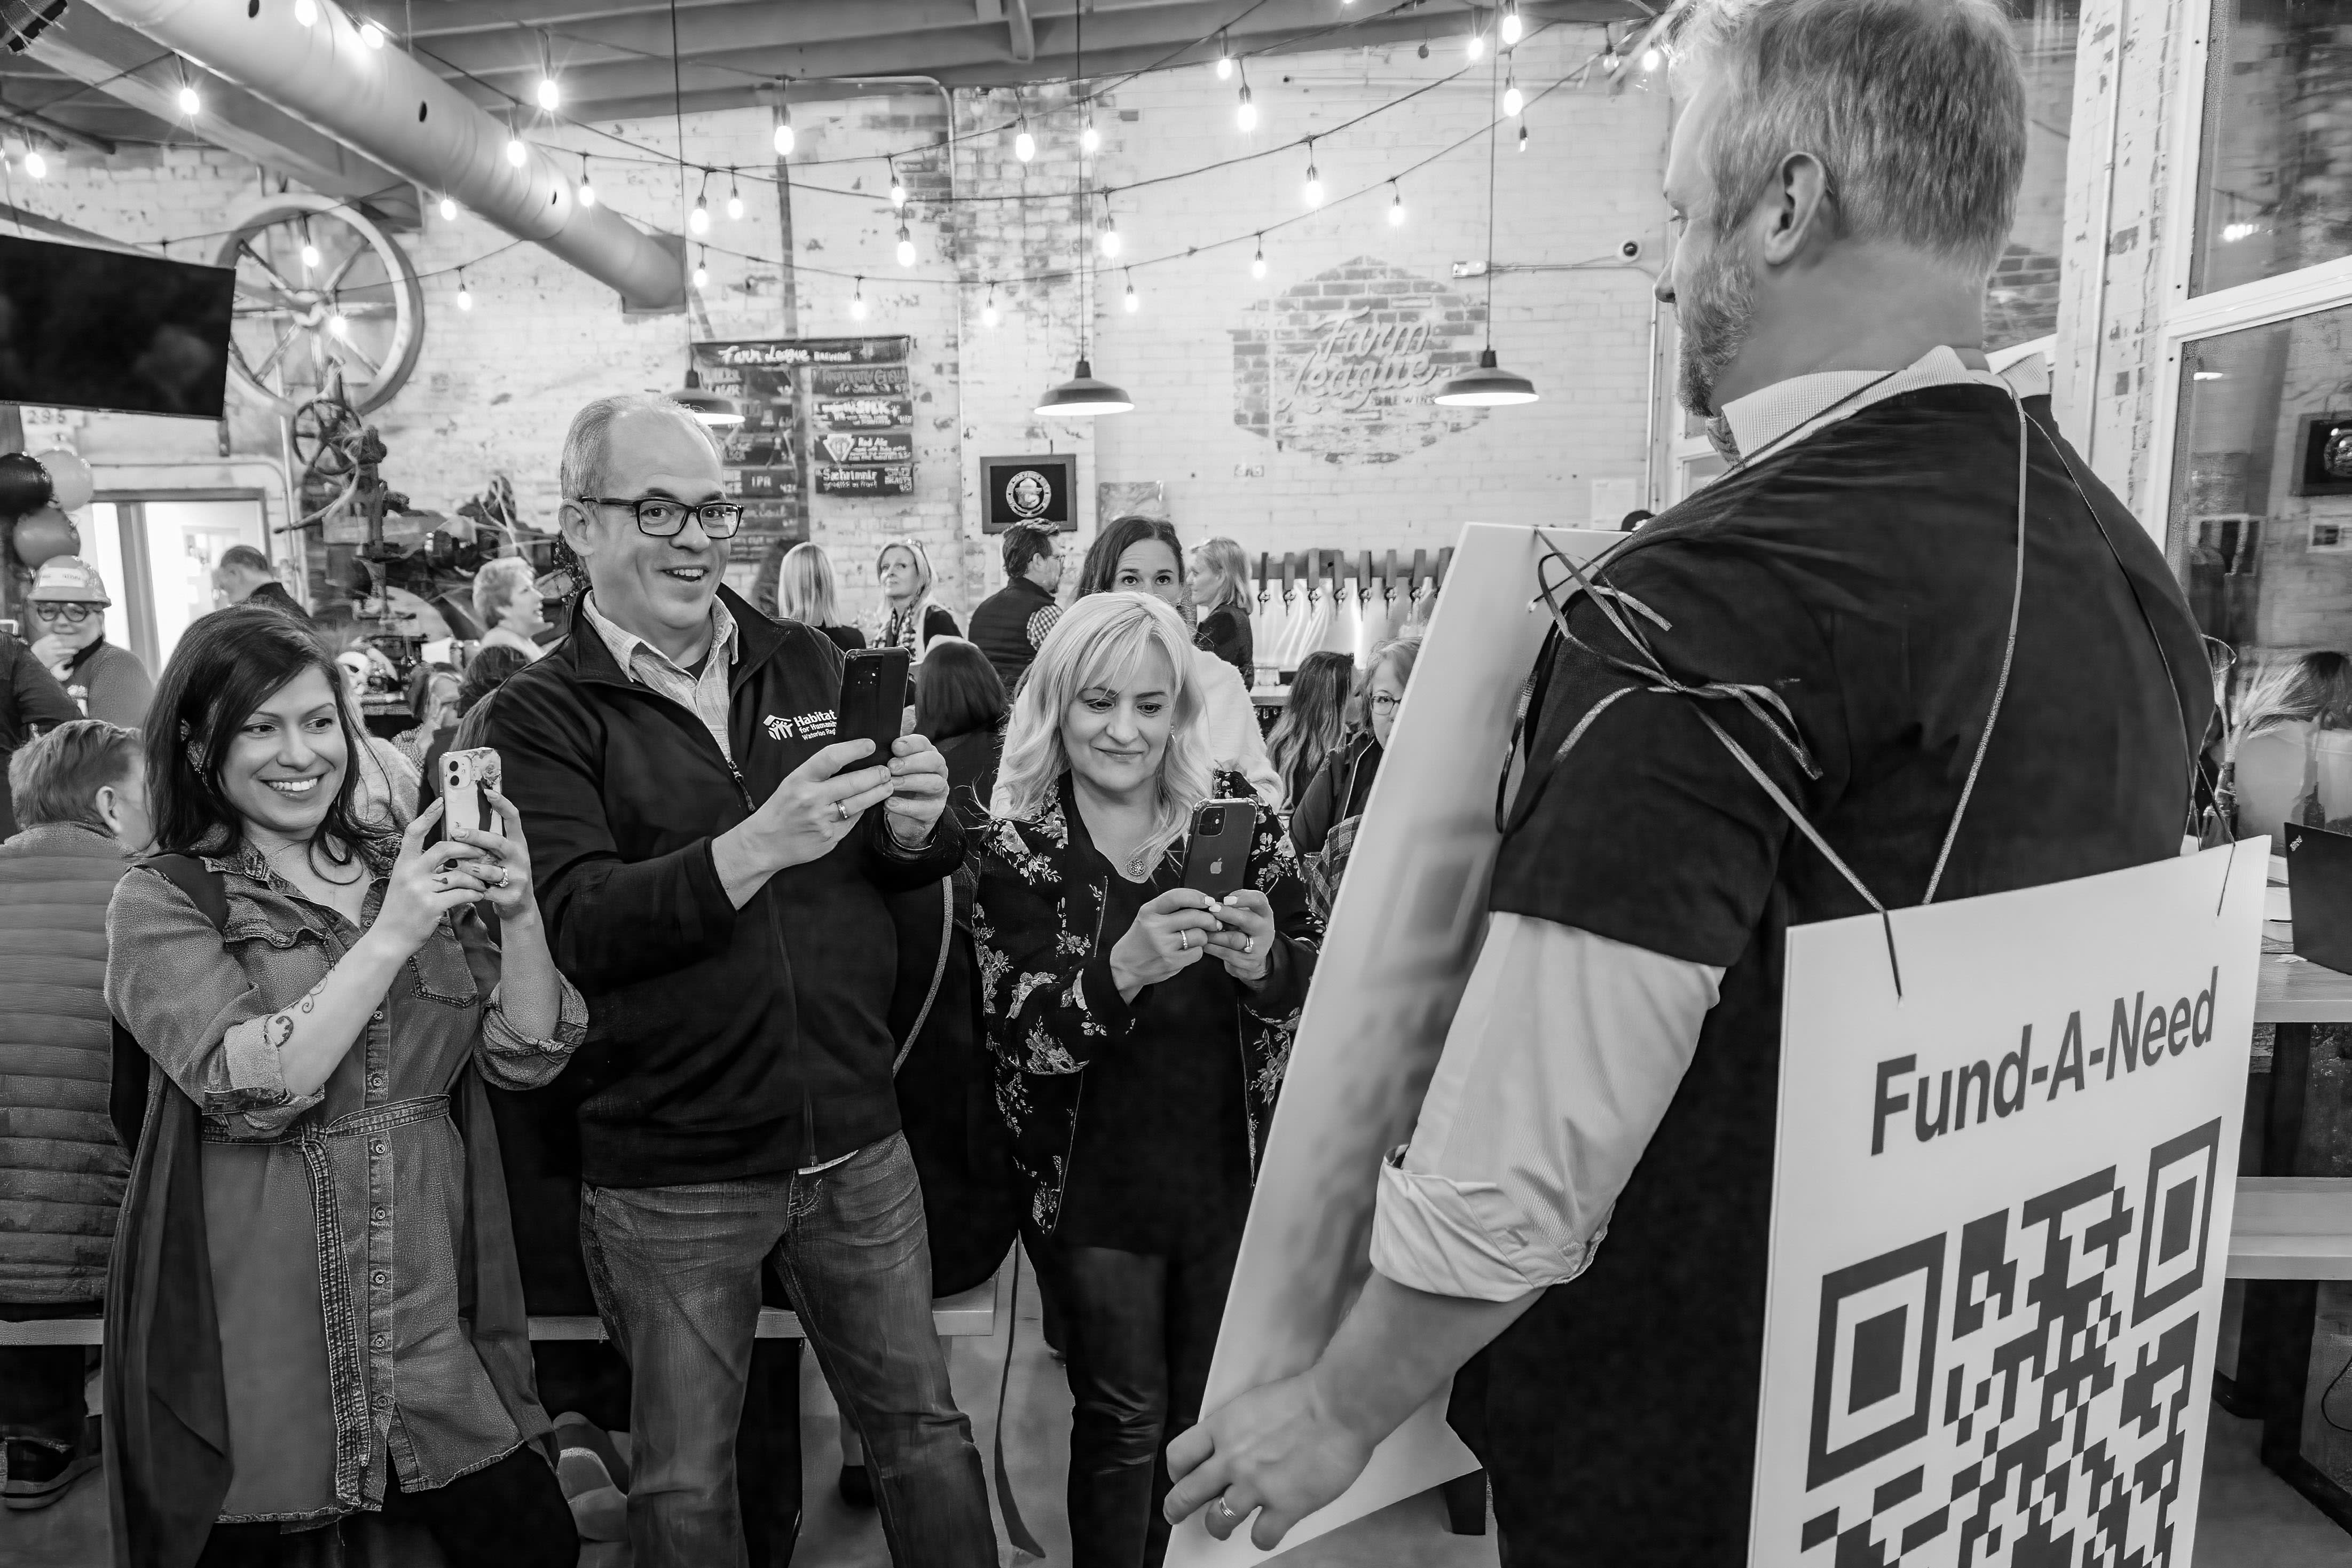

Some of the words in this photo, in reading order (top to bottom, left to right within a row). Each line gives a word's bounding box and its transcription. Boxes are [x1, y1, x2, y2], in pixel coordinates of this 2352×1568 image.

[1308, 306, 1430, 360] Farm
[1275, 350, 1439, 415] League
[752, 476, 771, 487] IPA
[793, 710, 837, 727] Habitat
[802, 730, 825, 740] Waterloo
[1871, 965, 2219, 1157] Fund-A-Need
